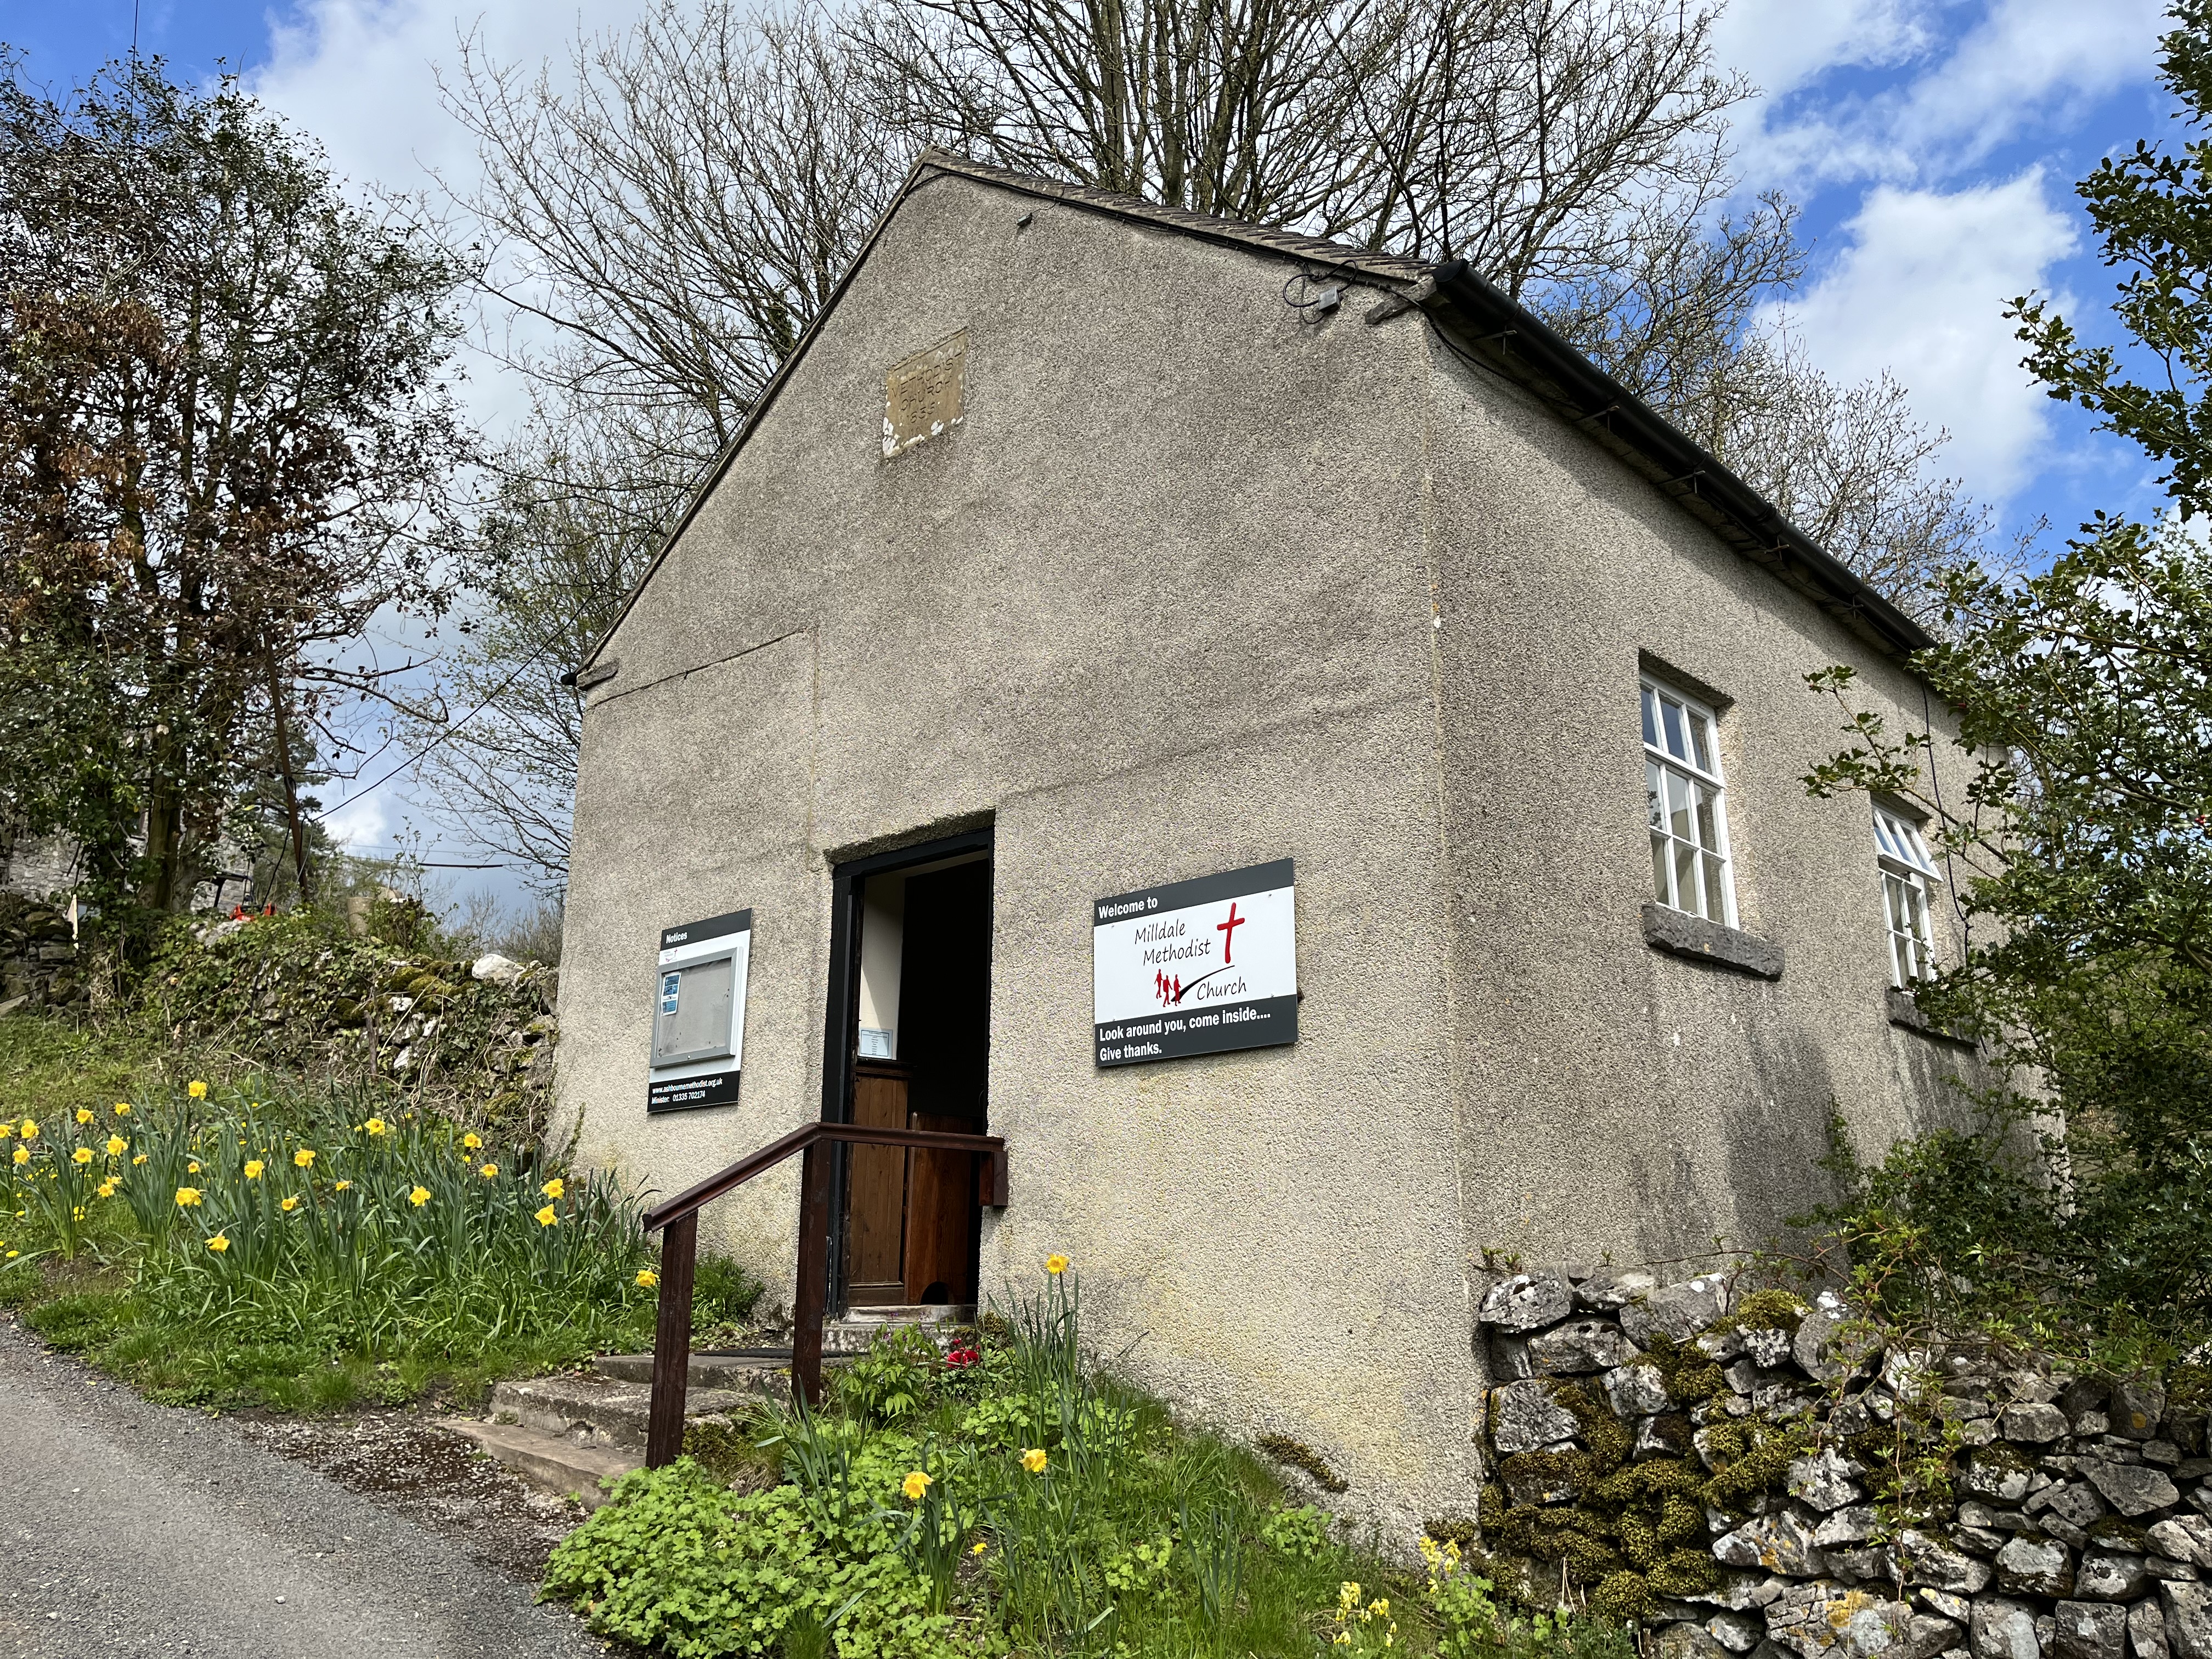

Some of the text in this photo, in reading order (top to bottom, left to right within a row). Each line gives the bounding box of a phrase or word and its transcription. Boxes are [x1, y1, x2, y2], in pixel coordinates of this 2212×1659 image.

[1098, 896, 1158, 919] Welcome to
[665, 932, 687, 944] Notices
[1135, 918, 1186, 945] Milldale
[1143, 938, 1211, 966] Methodist
[1197, 976, 1247, 1001] Church
[1099, 1006, 1271, 1042] Look around you, come inside....
[1099, 1041, 1163, 1062] Give thanks.
[651, 1090, 706, 1104] Minister: 01335 702174
[652, 1077, 723, 1094] www.ashbournemethodist.org.uk
